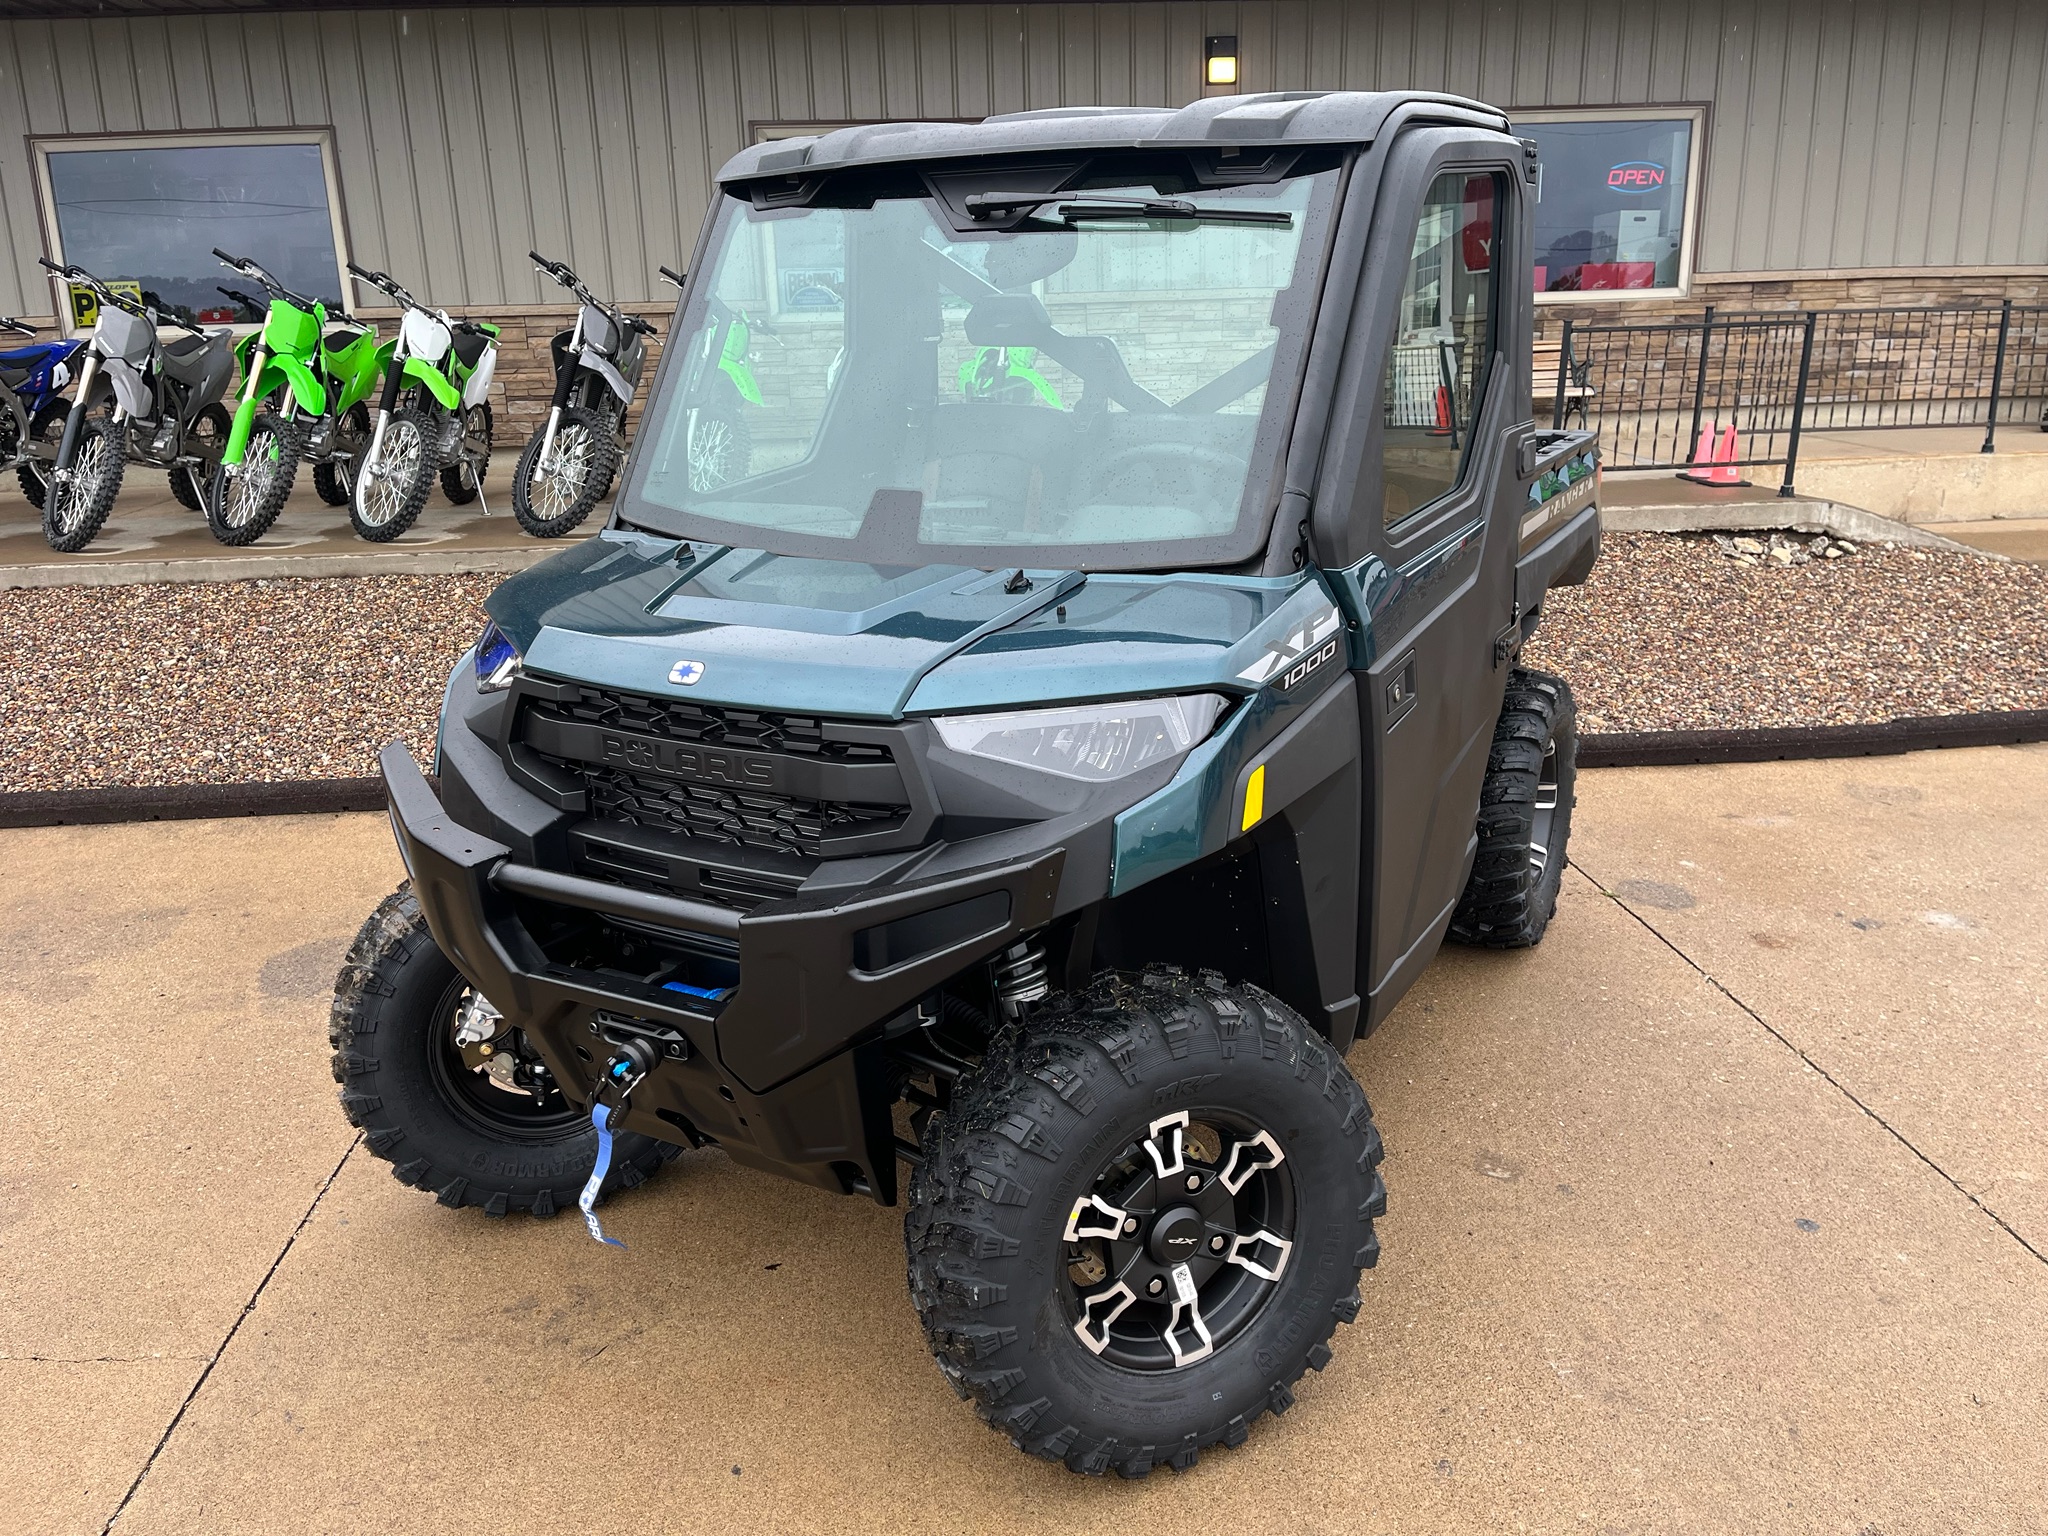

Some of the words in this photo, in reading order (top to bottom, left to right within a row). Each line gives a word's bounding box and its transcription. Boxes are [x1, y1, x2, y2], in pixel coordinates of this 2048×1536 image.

[1607, 169, 1665, 185] OPEN
[52, 361, 70, 389] 4
[1253, 603, 1338, 682] XP
[1284, 640, 1336, 690] 1000
[601, 734, 775, 786] POLARIS
